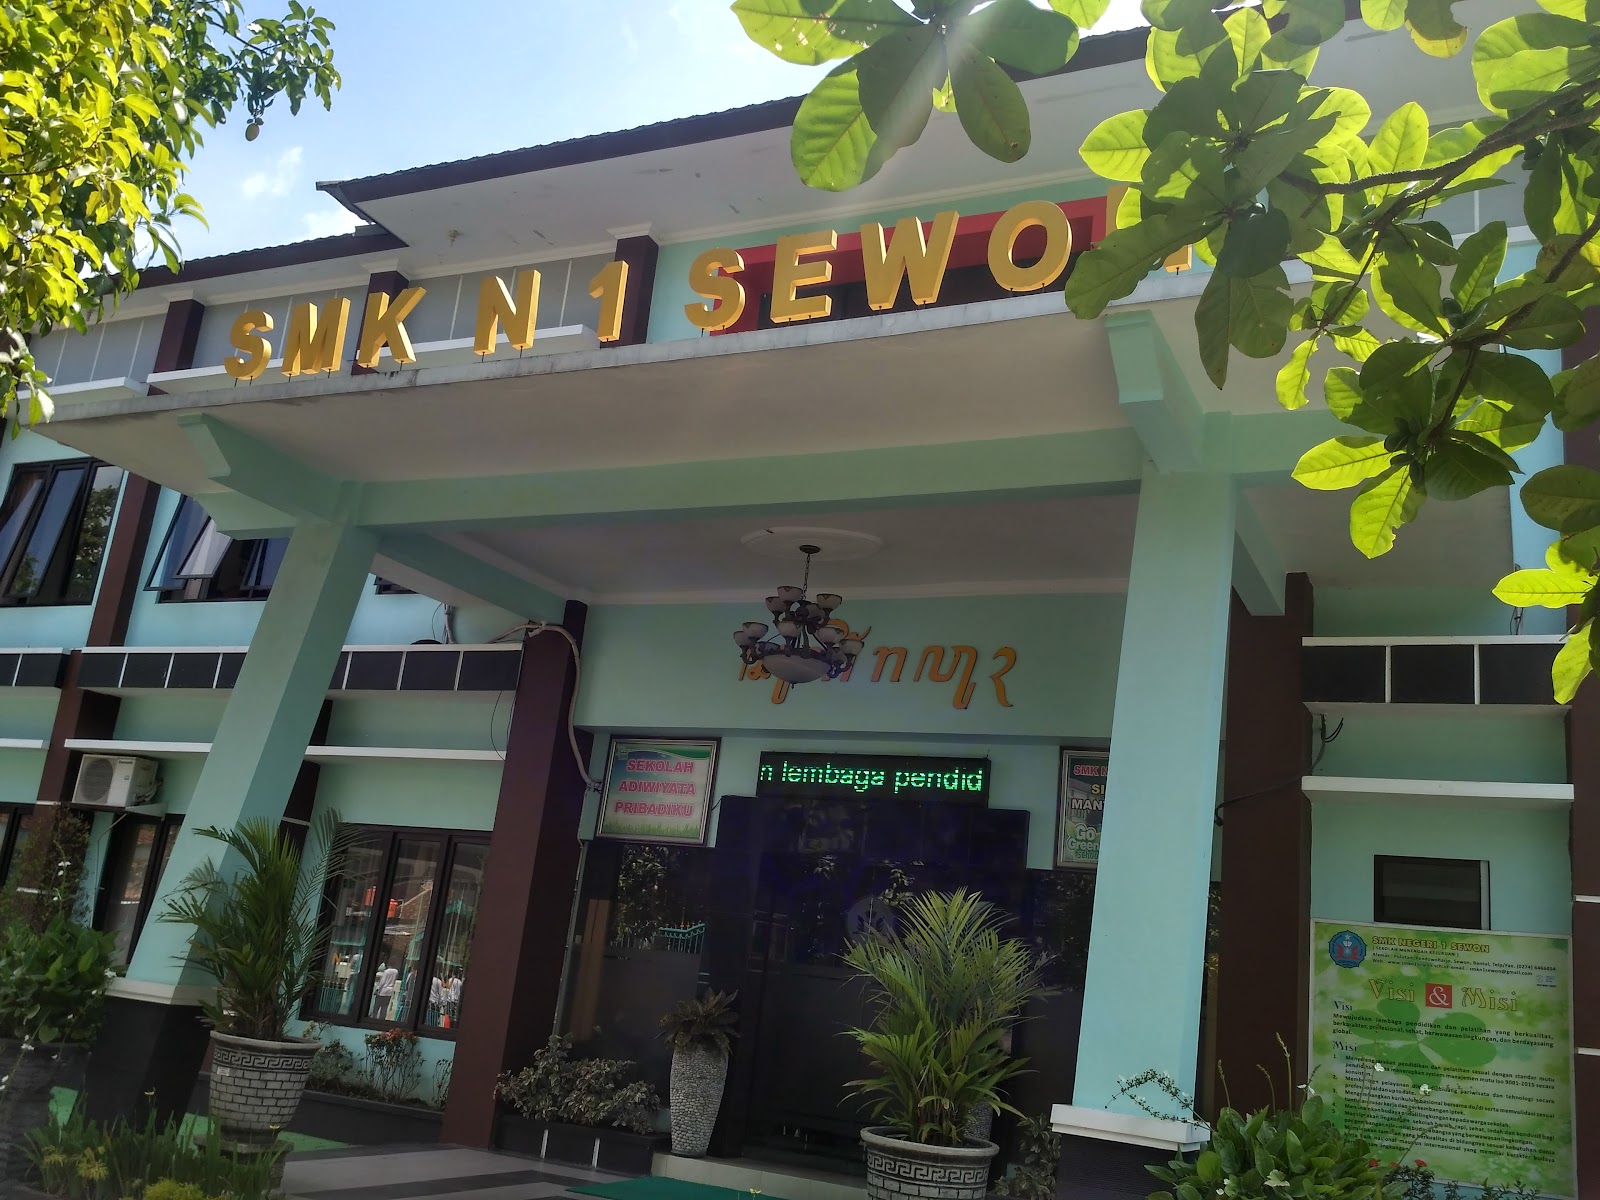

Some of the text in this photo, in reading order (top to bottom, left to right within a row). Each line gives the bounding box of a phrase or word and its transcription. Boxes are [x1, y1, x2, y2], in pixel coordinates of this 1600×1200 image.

[224, 184, 1193, 381] SMK N 1 SEWO
[626, 758, 695, 774] SEKOLAH
[1074, 764, 1100, 776] SMK
[760, 760, 984, 794] n lembaga pendid
[618, 780, 696, 796] ADIWIYATA
[614, 801, 694, 818] PRIBADIKU
[1076, 823, 1097, 841] Go
[1067, 839, 1100, 851] Green
[1371, 935, 1489, 953] SMK NEGERI 1 SEWON
[1368, 978, 1516, 1011] Visi & Misi
[1333, 1000, 1352, 1010] Visi
[1333, 1013, 1371, 1022] Mewujudkan
[1375, 1017, 1401, 1025] lembaga
[1405, 1020, 1440, 1029] pendidikan
[1460, 1025, 1490, 1034] pelatihan
[1332, 1040, 1356, 1052] Misi
